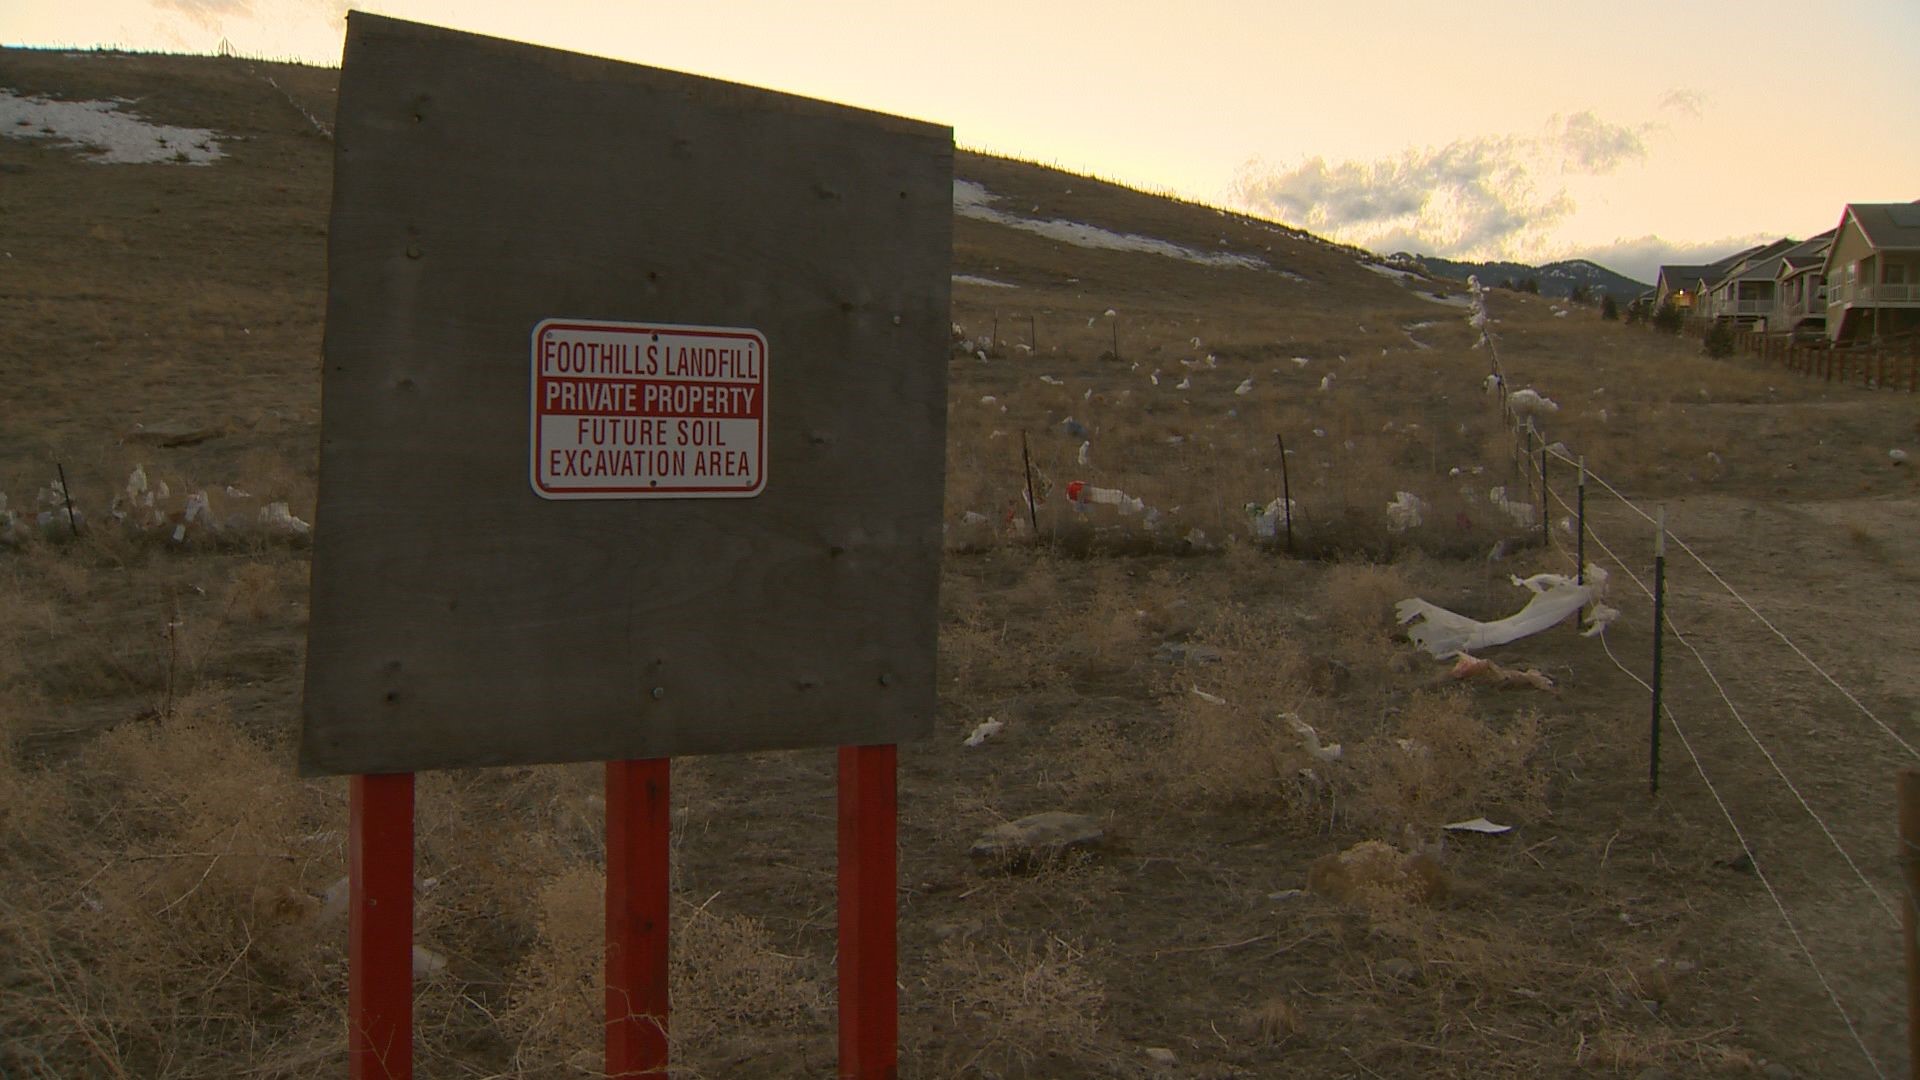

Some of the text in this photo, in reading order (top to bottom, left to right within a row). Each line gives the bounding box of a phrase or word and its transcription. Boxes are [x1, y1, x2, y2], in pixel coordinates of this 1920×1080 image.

[544, 341, 758, 379] FOOTHILLS LANDFILL
[546, 381, 755, 414] PRIVATE PROPERTY
[578, 418, 726, 446] FUTURE SOIL
[550, 449, 750, 477] EXCAVATION AREA
